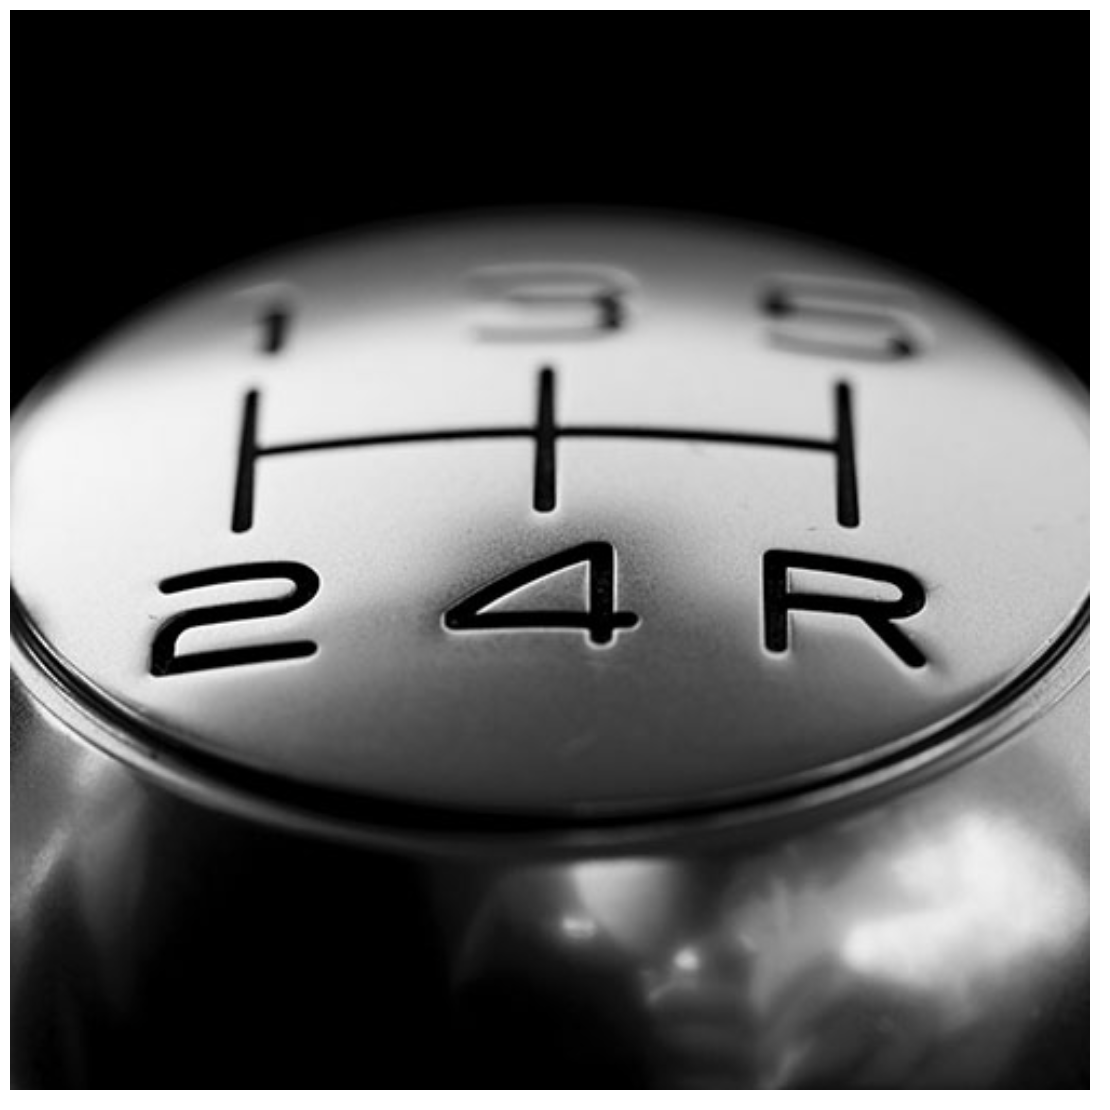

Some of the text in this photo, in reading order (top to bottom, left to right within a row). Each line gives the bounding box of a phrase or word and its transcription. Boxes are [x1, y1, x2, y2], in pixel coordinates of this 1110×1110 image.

[149, 540, 928, 678] 2 4 R
